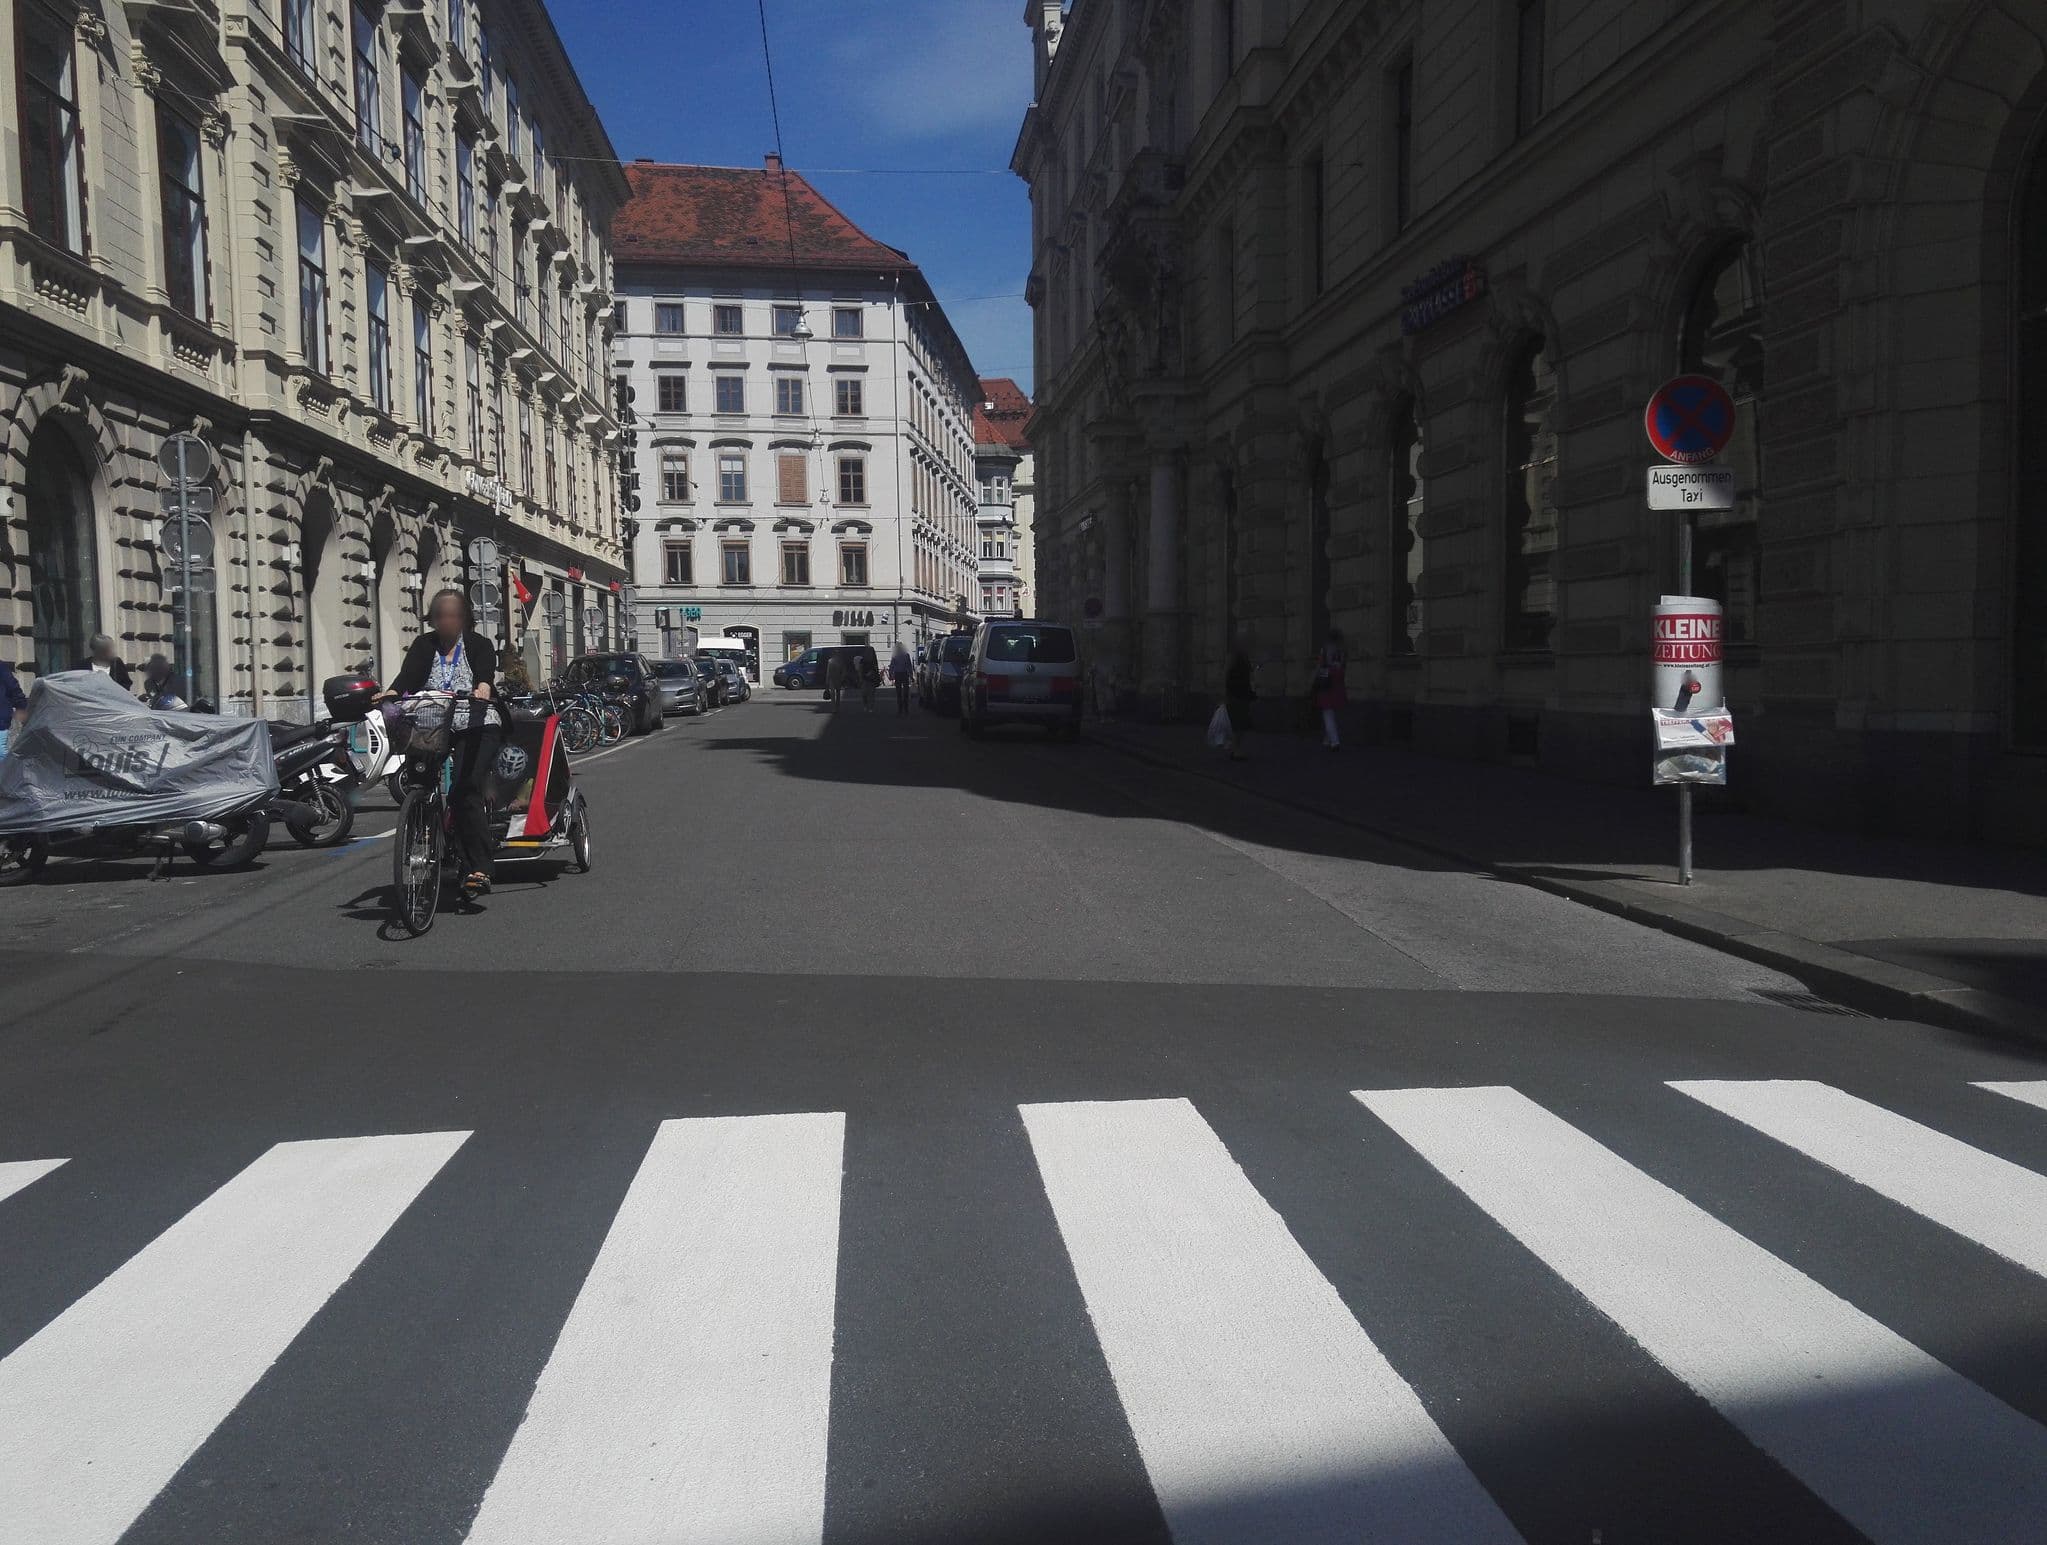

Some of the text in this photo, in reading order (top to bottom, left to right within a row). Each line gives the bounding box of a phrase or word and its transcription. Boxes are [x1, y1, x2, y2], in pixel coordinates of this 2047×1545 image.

[1670, 447, 1714, 462] ANFANG
[1652, 471, 1732, 488] Ausgenommen
[1681, 488, 1703, 503] Taxi
[1654, 618, 1721, 639] KLEINE
[1654, 644, 1721, 659] ZEITUNG
[128, 733, 167, 743] COMPANY
